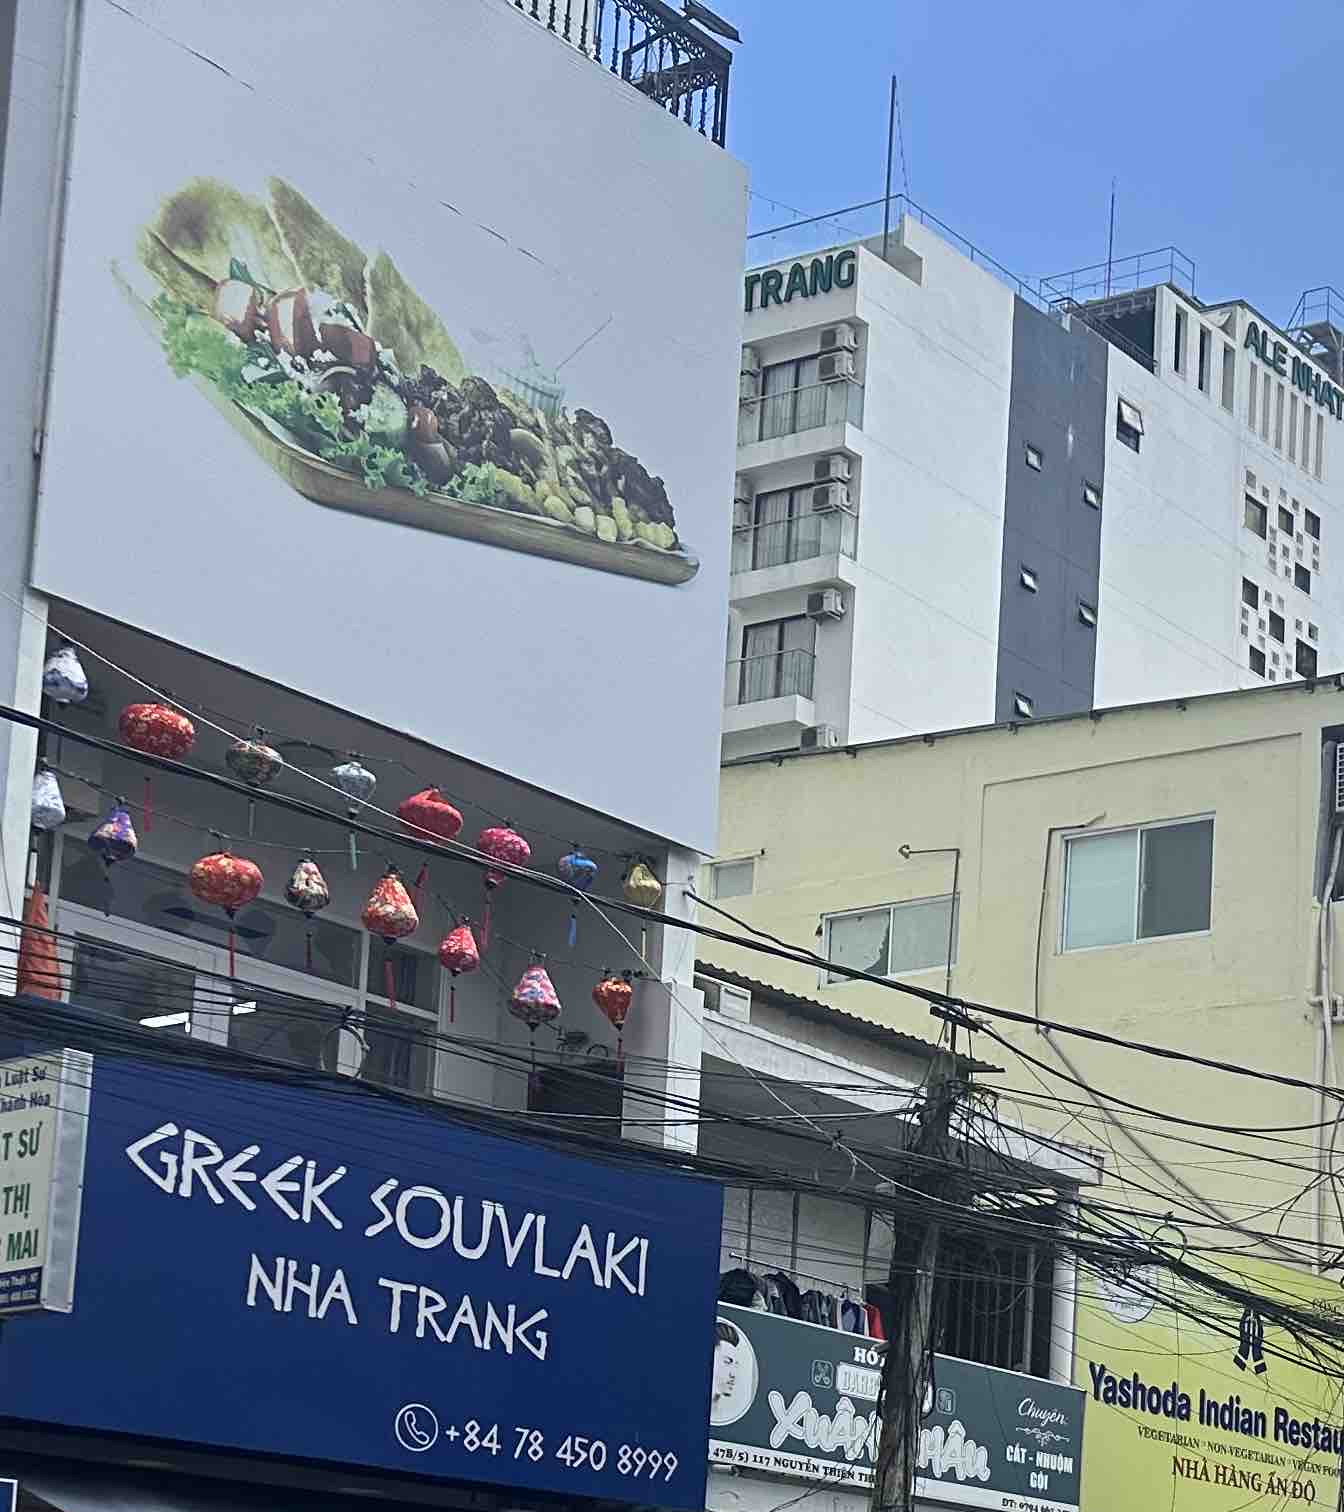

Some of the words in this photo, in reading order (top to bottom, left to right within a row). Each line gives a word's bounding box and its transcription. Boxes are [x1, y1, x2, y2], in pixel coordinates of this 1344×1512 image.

[1243, 319, 1287, 378] ALE
[126, 1122, 347, 1229] GREEK
[364, 1178, 650, 1296] SOUVLAKI
[7, 1228, 39, 1263] MAI
[247, 1254, 358, 1325] NHA
[378, 1278, 549, 1361] TRANG
[1088, 1360, 1192, 1423] Yashoda
[1199, 1387, 1266, 1439] Indian
[446, 1421, 502, 1458] +84
[513, 1428, 545, 1462] 78
[556, 1438, 607, 1471] 450
[616, 1444, 680, 1483] 8999
